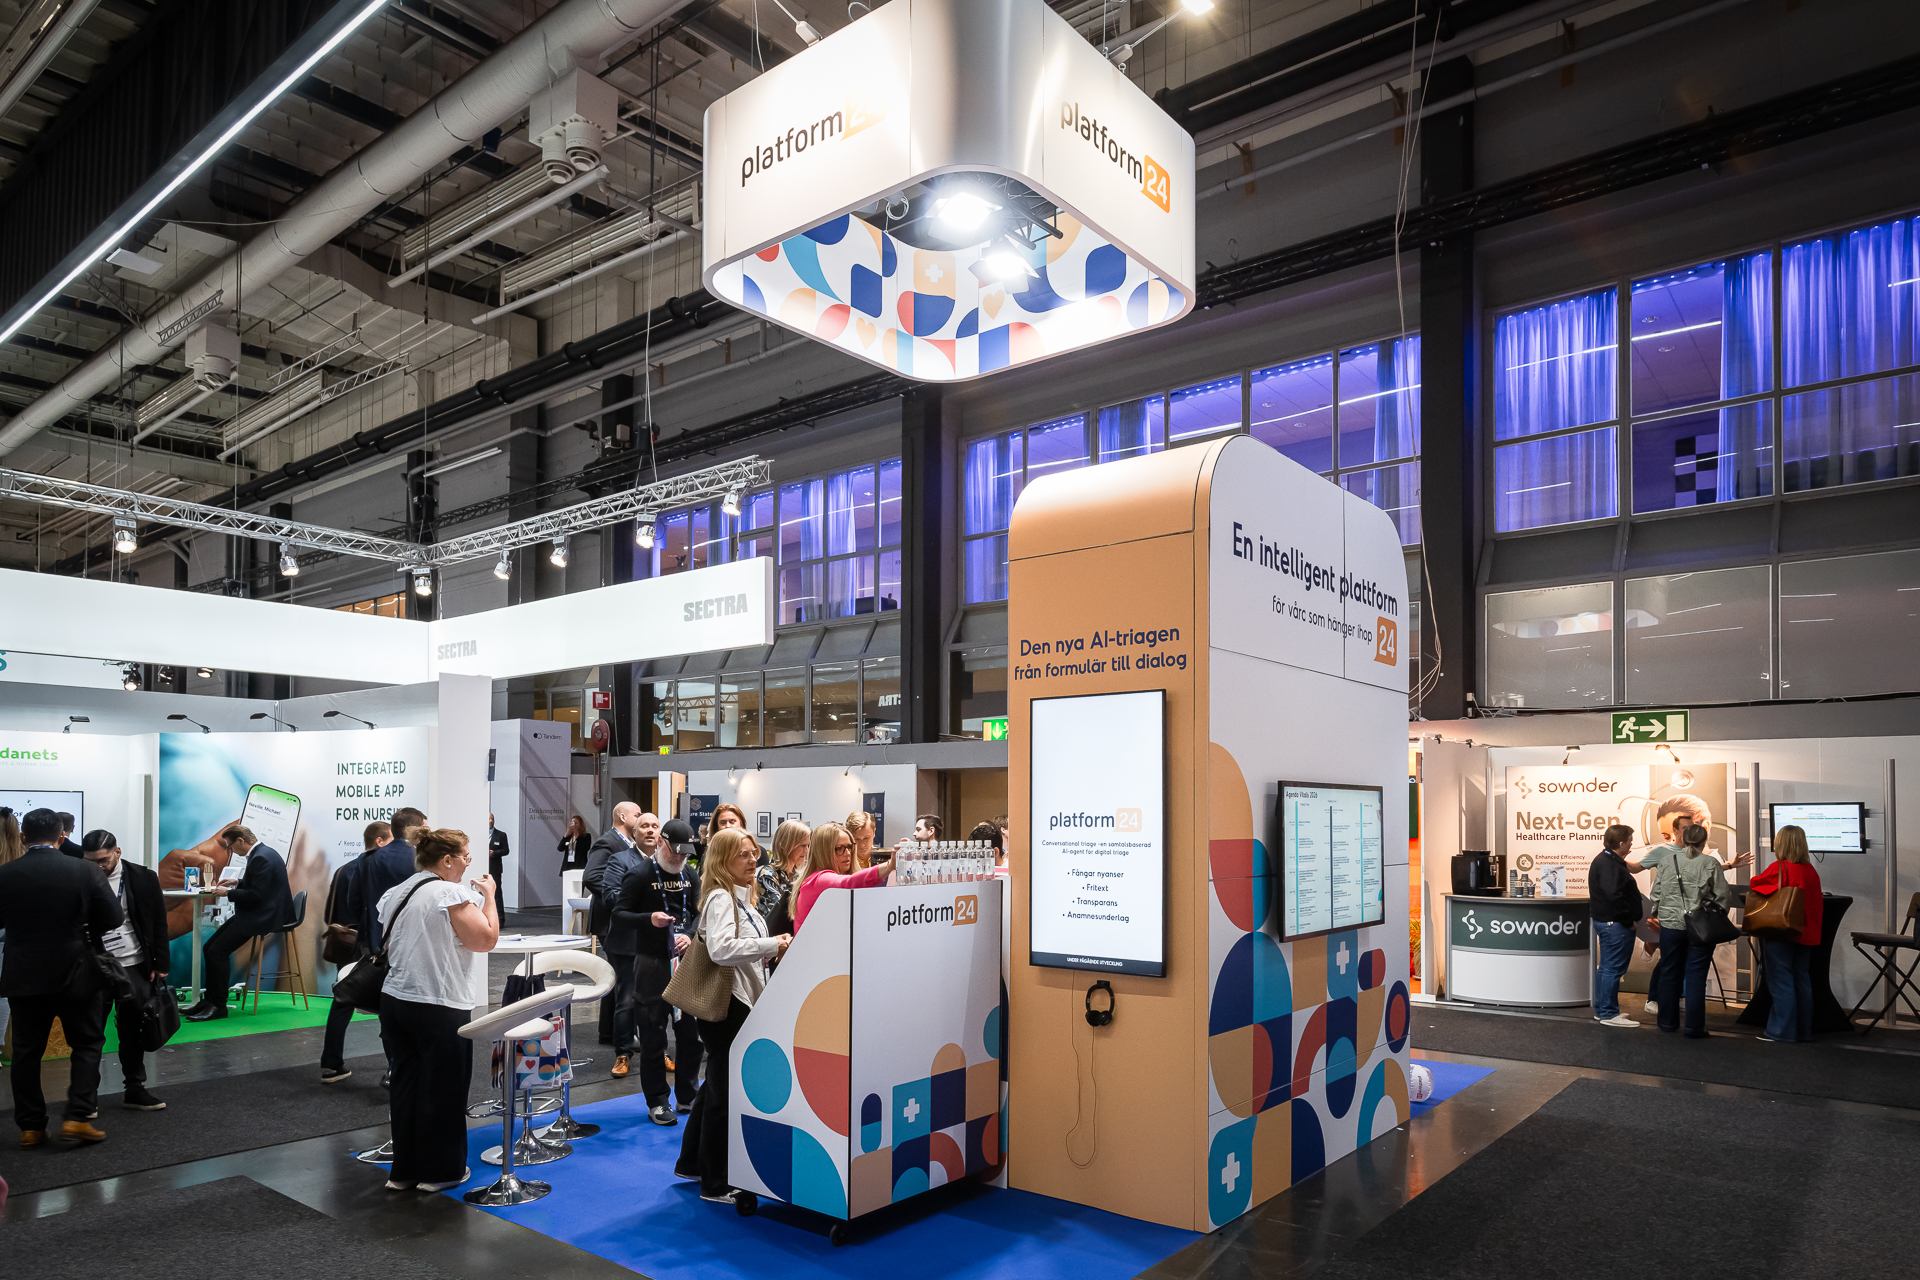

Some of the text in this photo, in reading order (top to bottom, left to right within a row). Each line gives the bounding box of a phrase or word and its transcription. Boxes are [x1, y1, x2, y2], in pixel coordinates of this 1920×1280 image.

[1233, 521, 1398, 616] En intelligent plattform
[683, 593, 748, 622] SECTRA
[1273, 595, 1286, 615] för
[1308, 611, 1325, 628] som
[1327, 614, 1355, 639] hänger
[1357, 624, 1373, 645] ihop
[1020, 627, 1180, 656] Den nya AI-triagen
[437, 639, 477, 661] SECTRA
[1014, 652, 1187, 680] från formulär till dialog
[337, 761, 406, 775] INTEGRATED
[336, 784, 405, 798] MOBILE APP
[1538, 777, 1618, 793] sownder
[336, 807, 359, 821] FOR
[1050, 812, 1139, 830] platform24
[1516, 811, 1621, 830] Next-Gen
[1081, 840, 1097, 848] triage
[1516, 832, 1605, 841] Healthcare Plannin
[1094, 849, 1112, 857] digital
[1112, 849, 1130, 857] triage
[1071, 869, 1124, 879] Fångar nyanser
[1086, 883, 1109, 892] Fritext
[1077, 897, 1118, 907] Transparans
[887, 899, 976, 931] platform24
[1067, 911, 1130, 923] Anamnesunderlag
[1490, 915, 1582, 935] sownder
